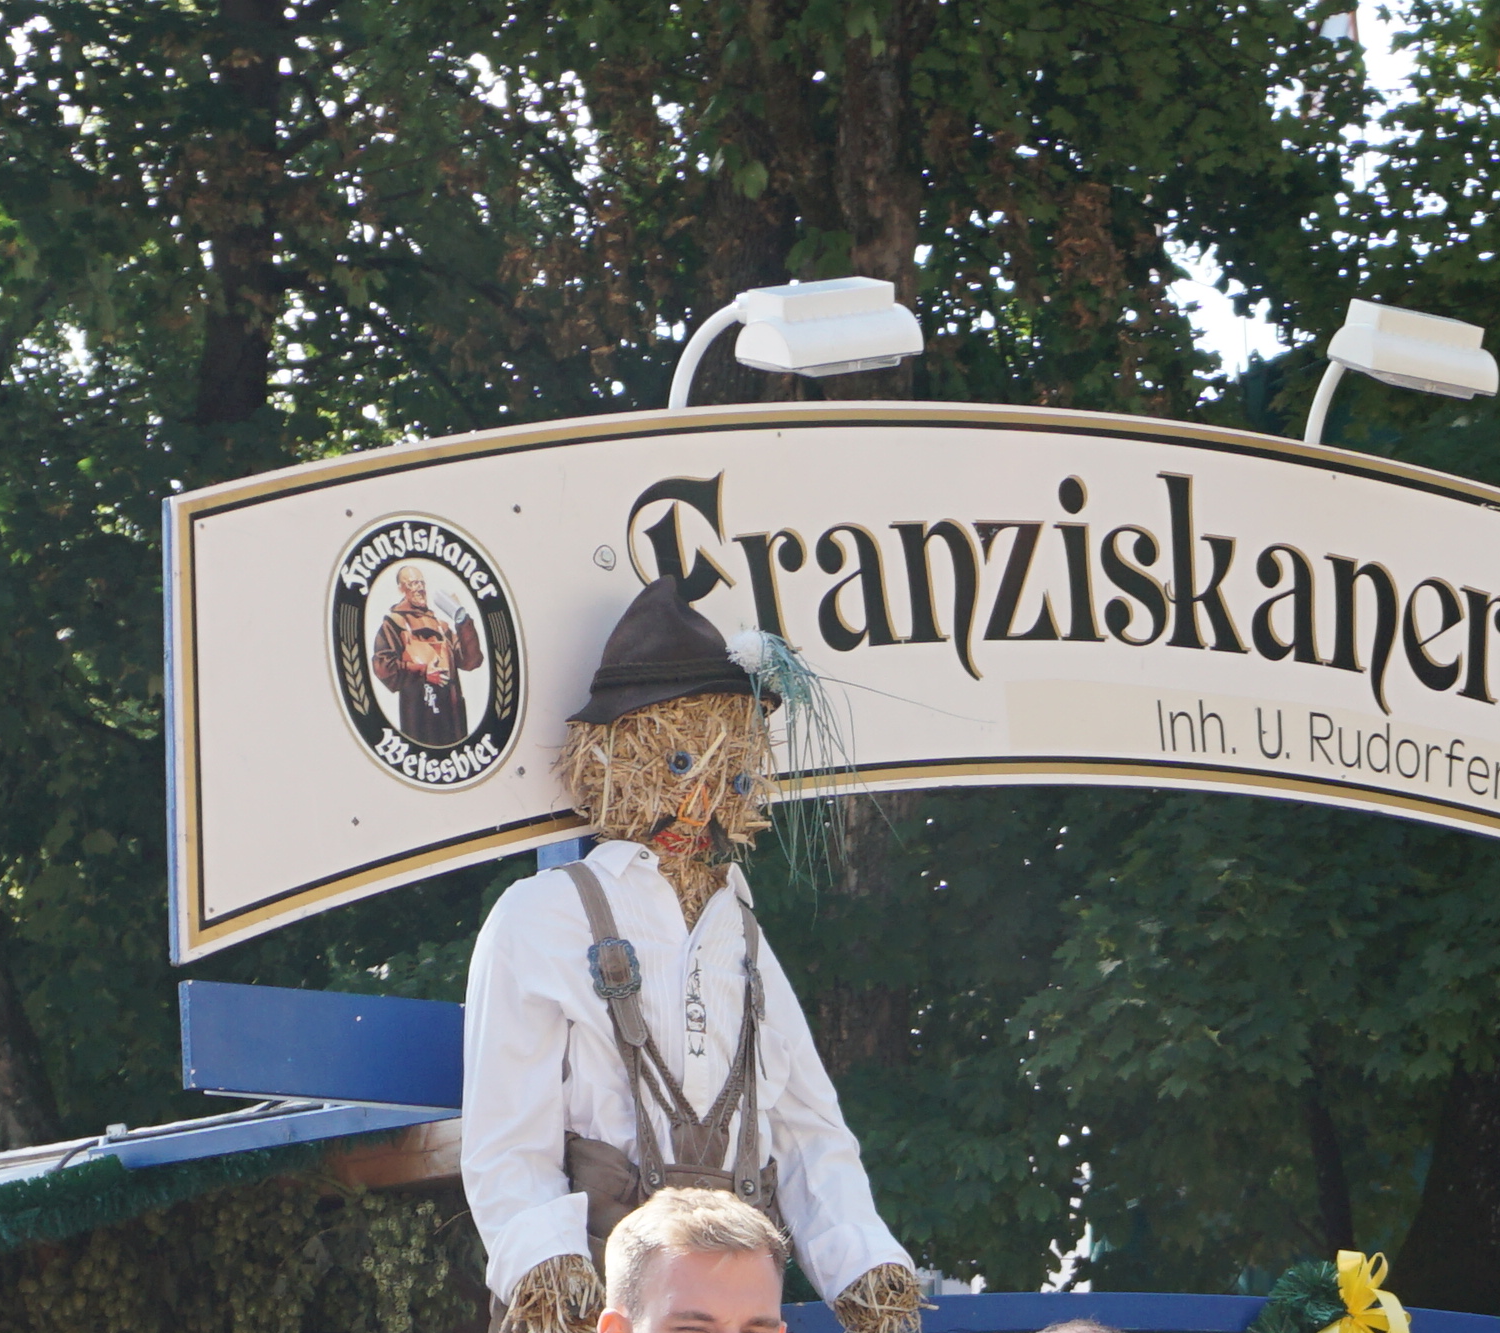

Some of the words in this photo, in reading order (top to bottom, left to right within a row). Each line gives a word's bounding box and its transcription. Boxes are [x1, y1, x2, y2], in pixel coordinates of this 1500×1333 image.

[340, 522, 498, 600] Franziskaner
[374, 728, 499, 782] Weissbier
[1156, 699, 1237, 755] Inh.
[1255, 706, 1290, 760] U.
